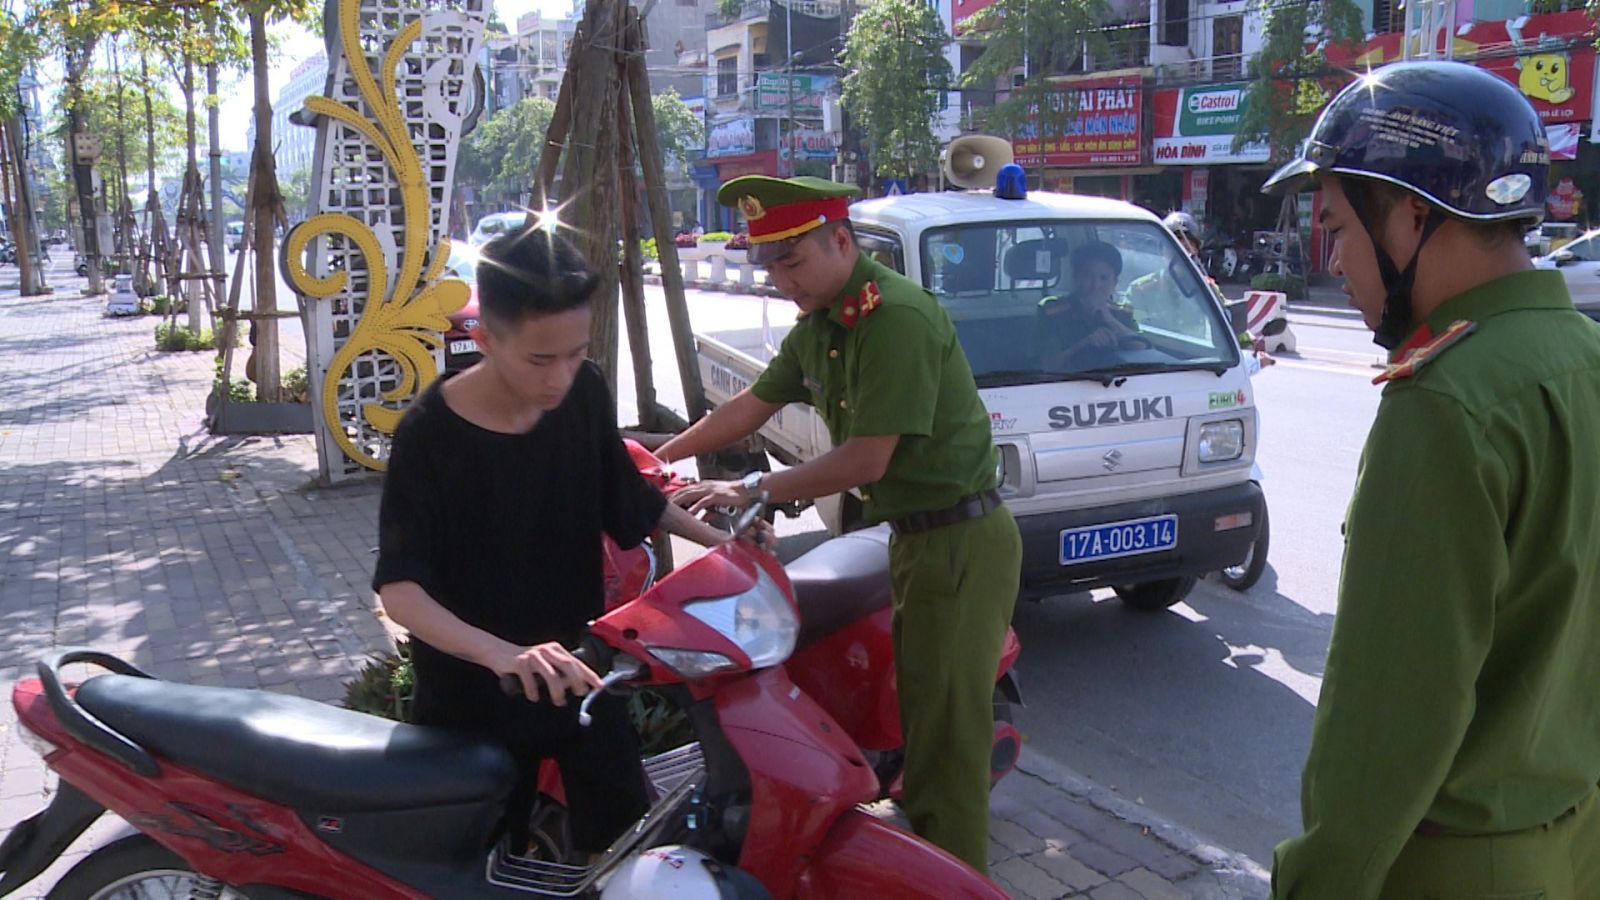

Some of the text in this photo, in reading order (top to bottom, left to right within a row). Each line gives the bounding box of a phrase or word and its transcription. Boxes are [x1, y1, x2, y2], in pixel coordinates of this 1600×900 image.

[1201, 95, 1237, 109] Castrol
[1156, 141, 1207, 159] HÒA BÌNH
[1048, 396, 1173, 429] SUZUKI
[1068, 522, 1172, 558] 17A-003.14
